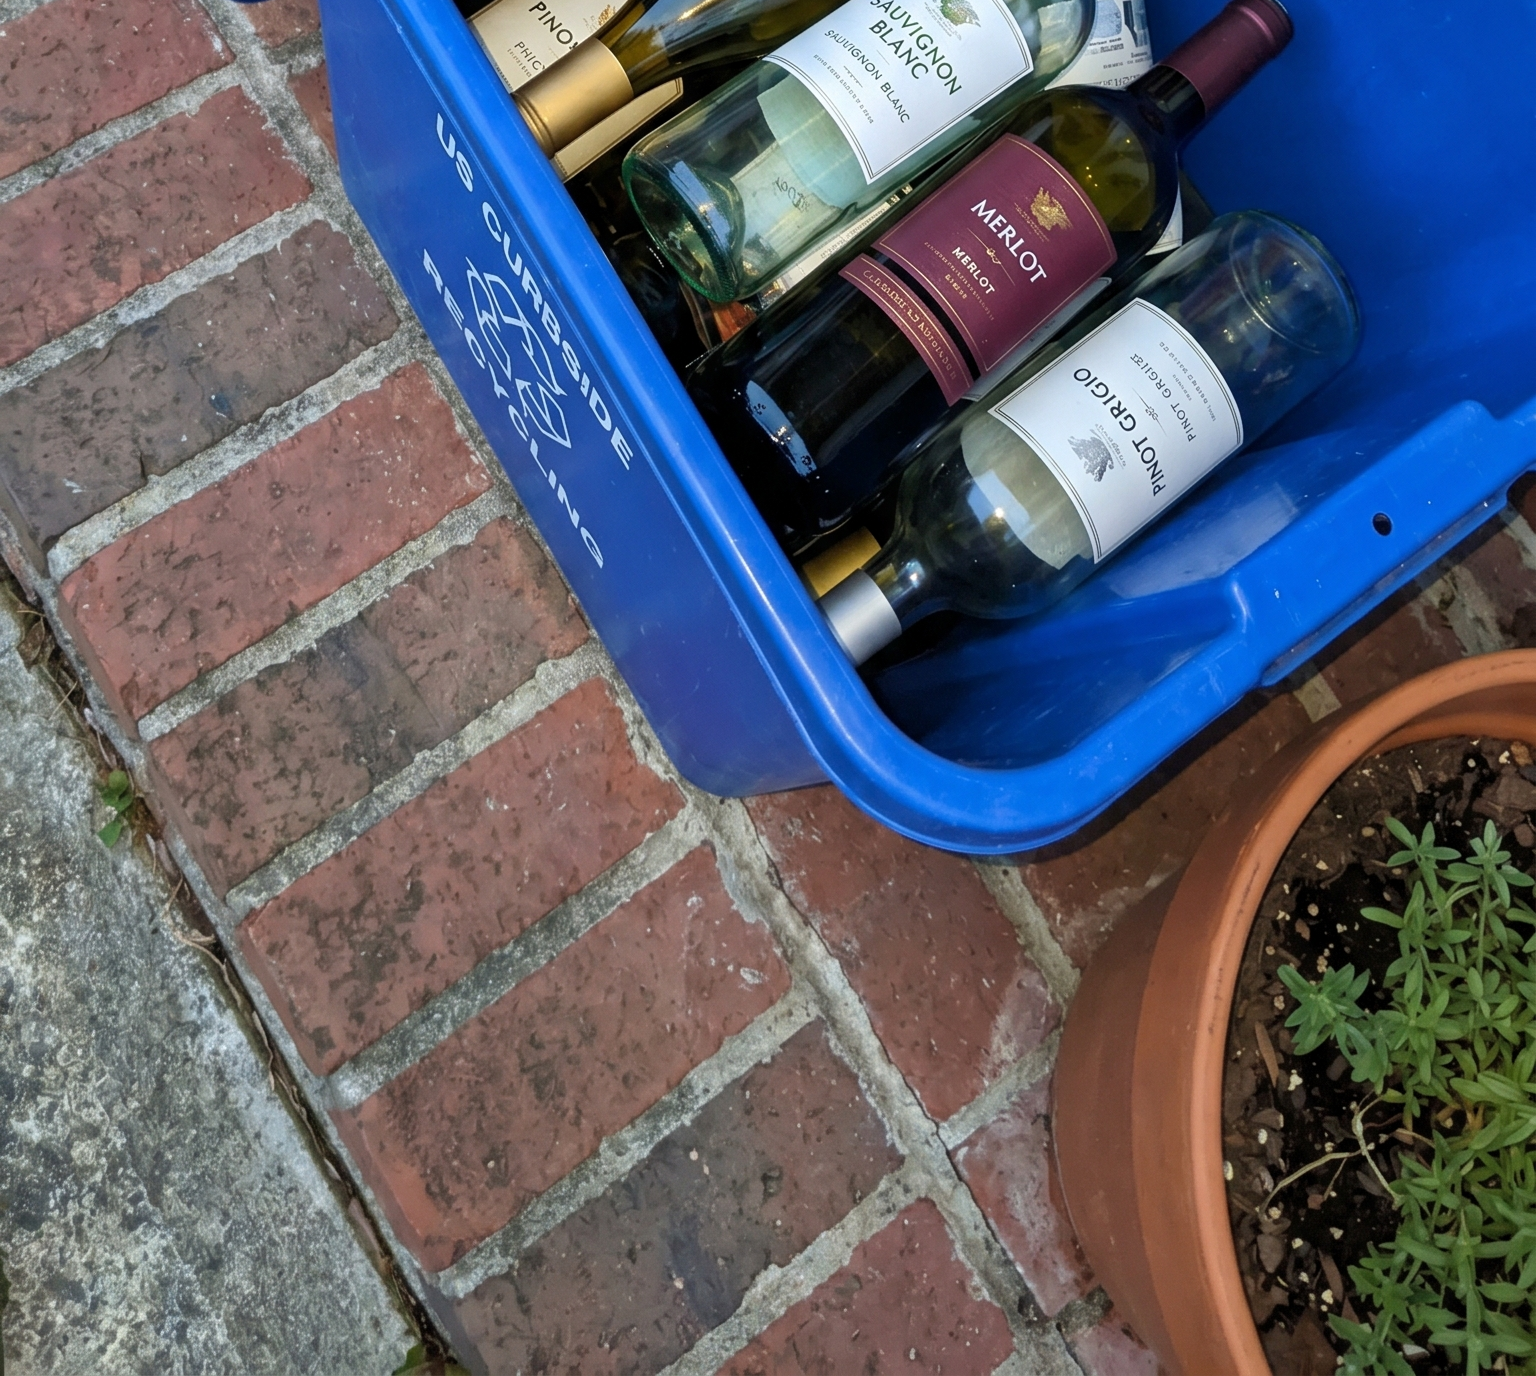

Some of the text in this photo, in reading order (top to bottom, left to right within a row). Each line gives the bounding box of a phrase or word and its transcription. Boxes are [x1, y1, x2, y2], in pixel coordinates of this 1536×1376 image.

[514, 41, 546, 71] PHIC
[824, 29, 883, 81] SAUVIGNON
[880, 82, 910, 124] BLANC
[869, 19, 929, 80] BLANC
[952, 246, 996, 295] MERLOT
[970, 199, 1047, 283] MERLOT
[436, 113, 634, 471] US CURBSIDE
[423, 248, 604, 569] RECYCLING
[1073, 368, 1137, 432] GRIGIO
[1170, 402, 1197, 442] PINOT
[1132, 436, 1167, 497] PINOT
